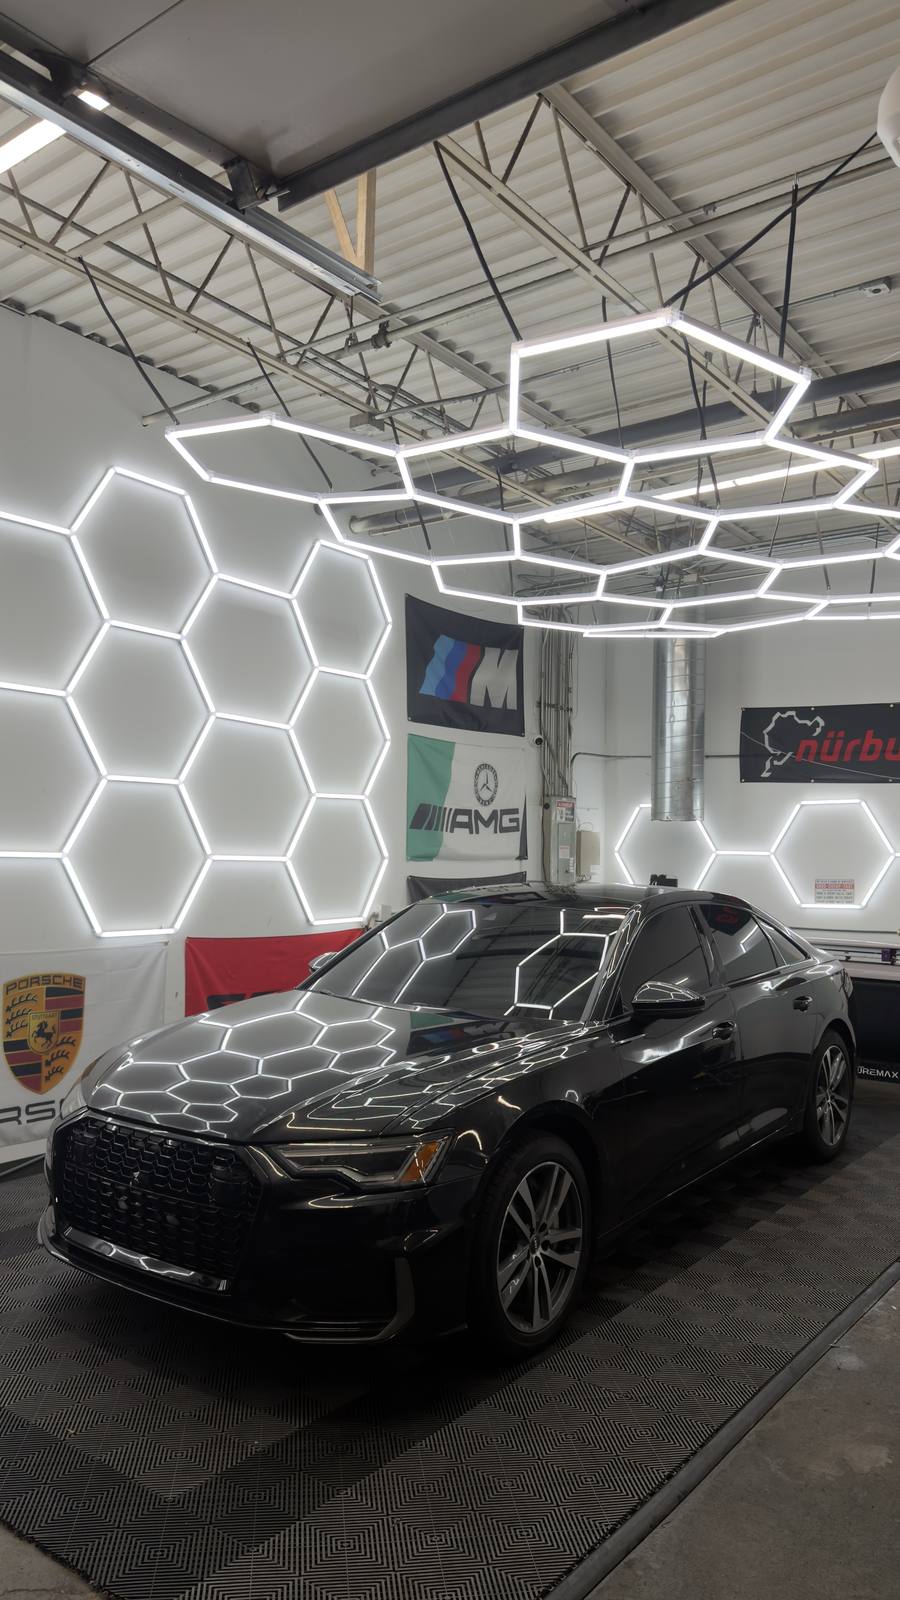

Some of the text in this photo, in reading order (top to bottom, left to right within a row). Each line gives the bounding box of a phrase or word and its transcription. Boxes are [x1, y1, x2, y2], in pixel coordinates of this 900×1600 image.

[470, 647, 519, 710] M
[449, 808, 520, 834] AMG
[6, 975, 84, 995] PORSCHE
[0, 1099, 65, 1125] RS
